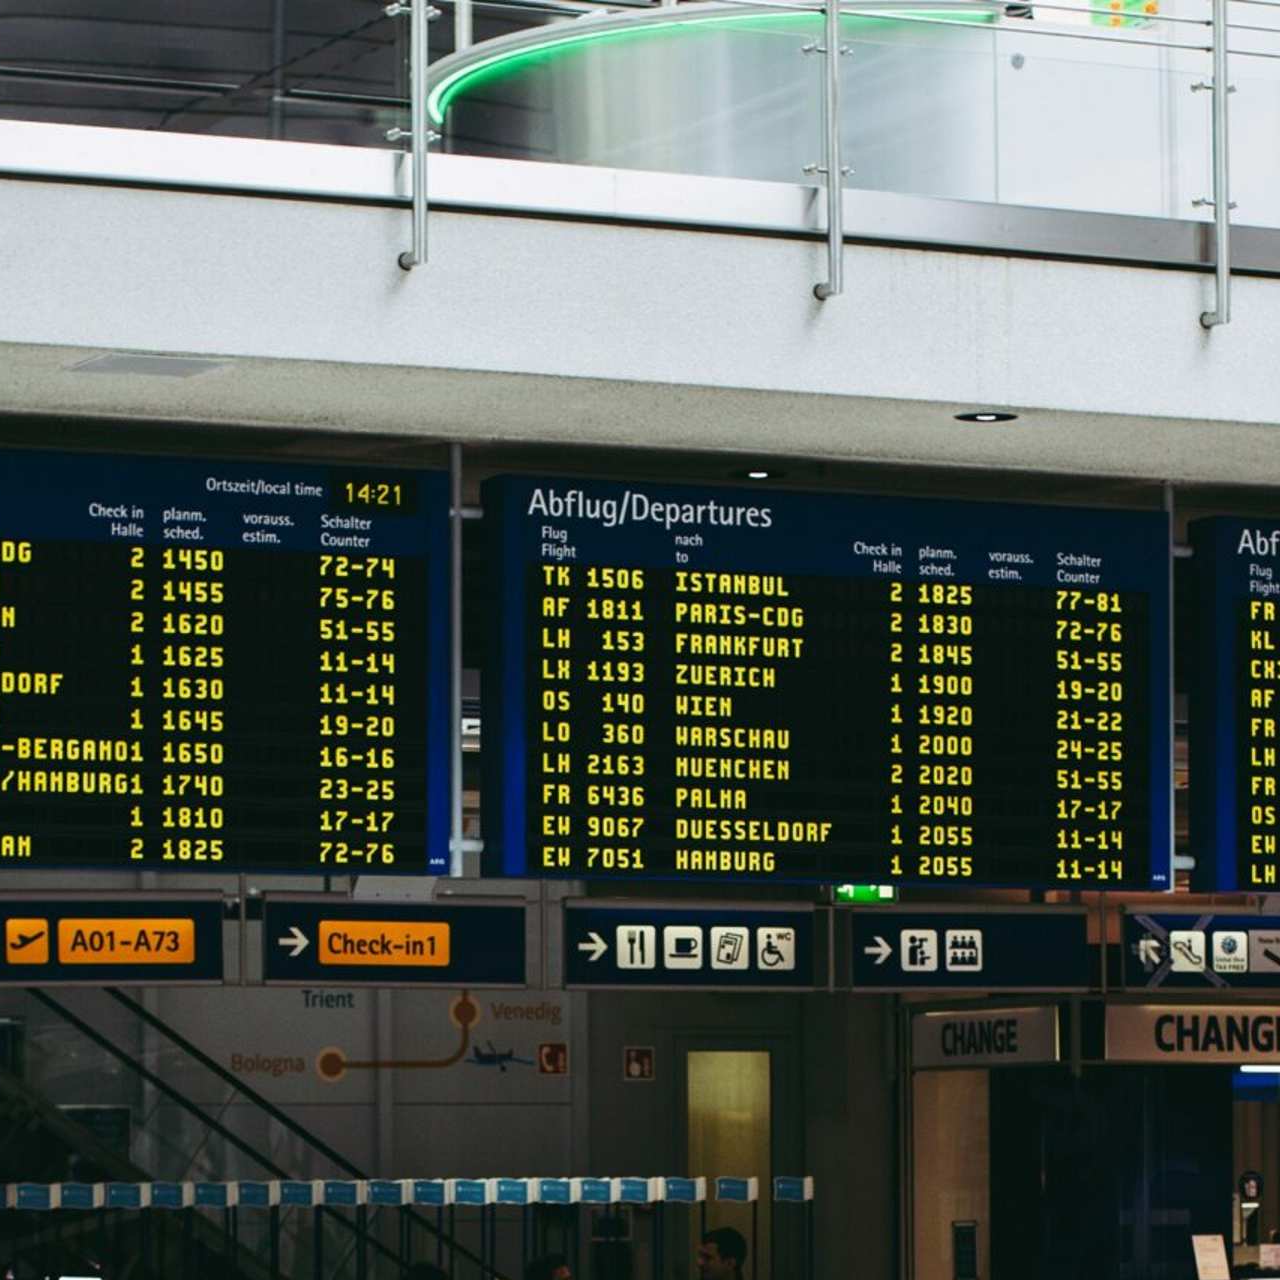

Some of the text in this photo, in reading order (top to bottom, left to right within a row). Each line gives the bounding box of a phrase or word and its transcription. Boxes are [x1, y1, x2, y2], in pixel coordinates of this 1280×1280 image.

[205, 477, 323, 498] Ortszeit/local time
[345, 482, 402, 505] 14:21
[88, 502, 145, 520] Check in
[162, 507, 207, 524] planm.
[242, 512, 295, 527] vorauss.
[527, 488, 773, 529] Abflug/Departures
[111, 521, 145, 538] Halle
[162, 525, 205, 541] sched.
[320, 514, 373, 531] Schalter
[241, 529, 282, 544] estim.
[320, 532, 371, 549] Counter
[130, 548, 144, 567] 2
[163, 549, 224, 570] 1450
[320, 556, 395, 577] 72-74
[543, 566, 1121, 612] TK 1506 ISTANBUL 2 1825 77-81
[542, 597, 1122, 642] AF 1811 PARIS-CDG 2 1830 72-76
[1250, 602, 1275, 620] FR
[130, 612, 144, 632] 2
[162, 613, 224, 635] 1620
[320, 620, 395, 641] 51-55
[542, 628, 1122, 671] LH 153 FRANKFURT 2 1845 51-55
[130, 677, 144, 696] 1
[162, 678, 224, 699] 1630
[320, 684, 395, 704] 11-14
[1251, 689, 1275, 707] AF
[130, 709, 144, 729] 1
[162, 710, 224, 731] 1645
[320, 715, 395, 736] 19-20
[543, 691, 1122, 731] OS 140 WIEN 1 1920 21-22
[130, 741, 145, 762] 1
[162, 742, 224, 764] 1650
[320, 747, 395, 768] 16-16
[1251, 748, 1276, 765] LH
[130, 807, 144, 826] 1
[162, 807, 223, 828] 1810
[320, 811, 394, 831] 17-17
[1251, 806, 1276, 824] OS
[543, 816, 1123, 849] EW 9067 DUESSELDORF 1 2055 11-14
[1251, 835, 1276, 853] EW
[70, 930, 180, 953] A01-A73
[777, 932, 791, 941] WC
[301, 989, 354, 1008] Trient
[491, 1001, 563, 1024] Venedig
[941, 1018, 1018, 1056] CHANGE
[230, 1053, 306, 1076] Bologna
